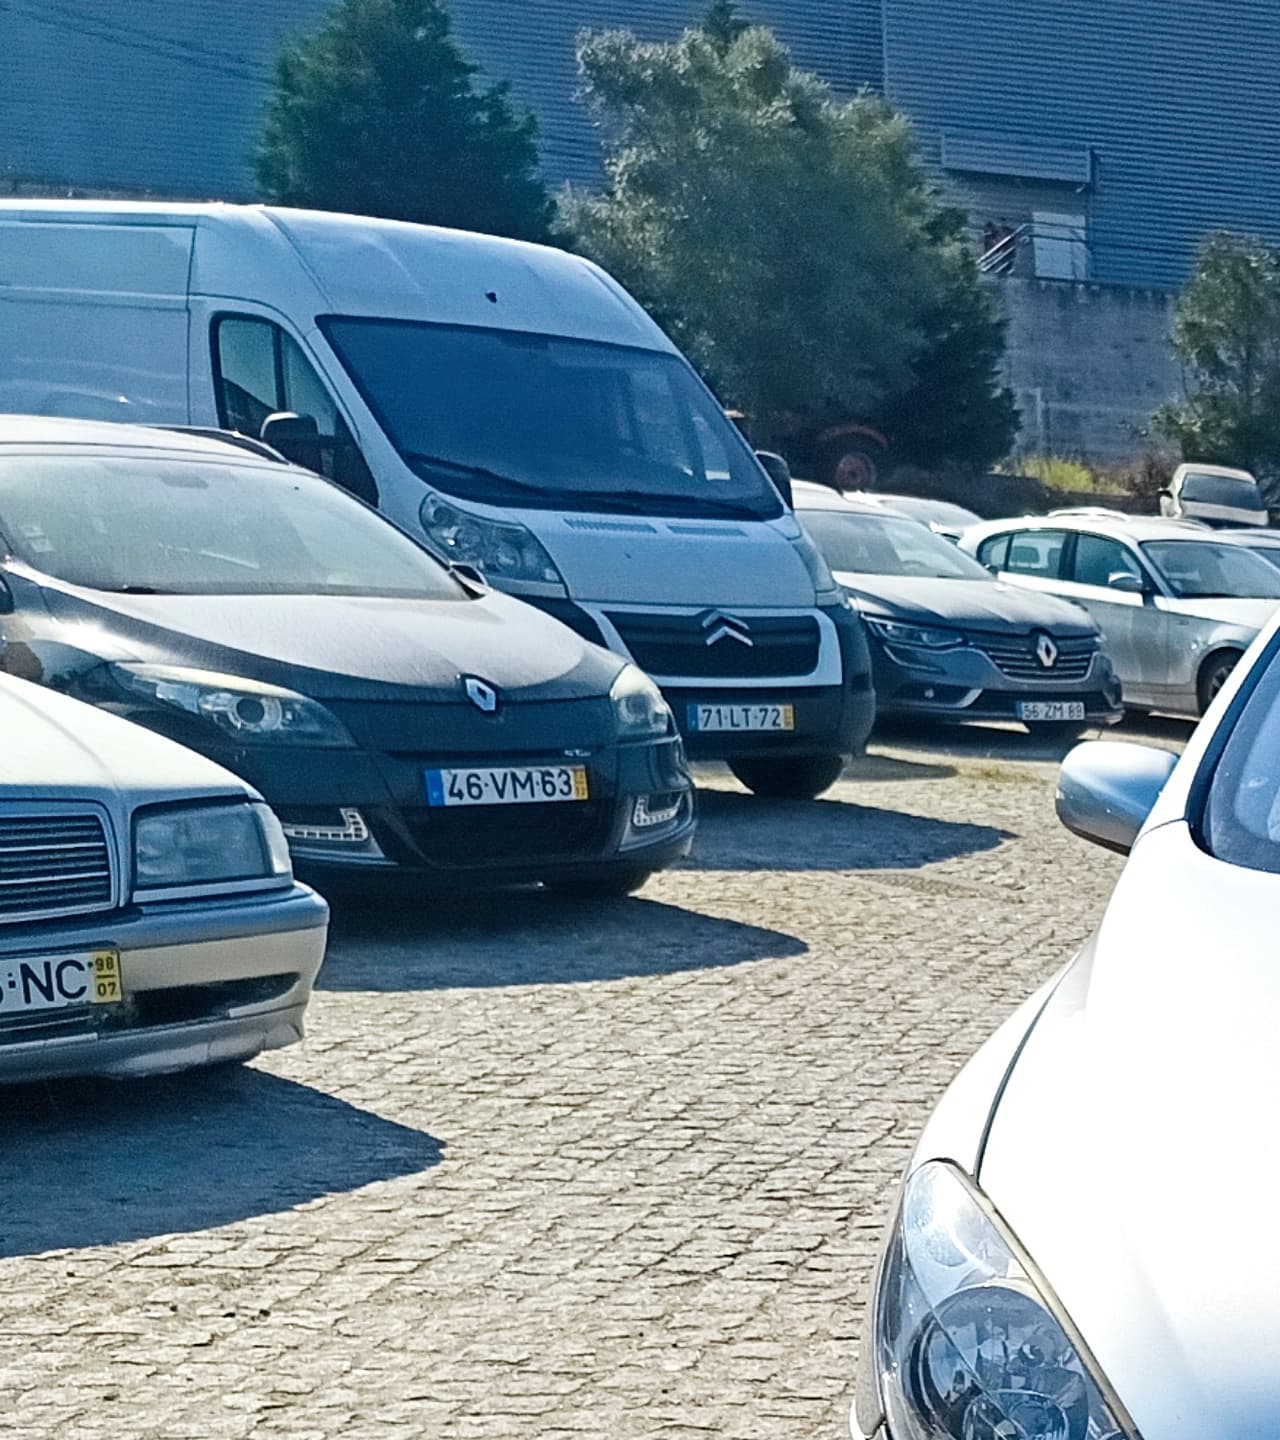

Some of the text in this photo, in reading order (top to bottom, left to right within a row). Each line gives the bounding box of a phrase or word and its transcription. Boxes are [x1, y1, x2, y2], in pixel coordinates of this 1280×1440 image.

[448, 769, 573, 800] 46·VM·63
[0, 959, 87, 1004] ·NC
[96, 982, 117, 997] 07
